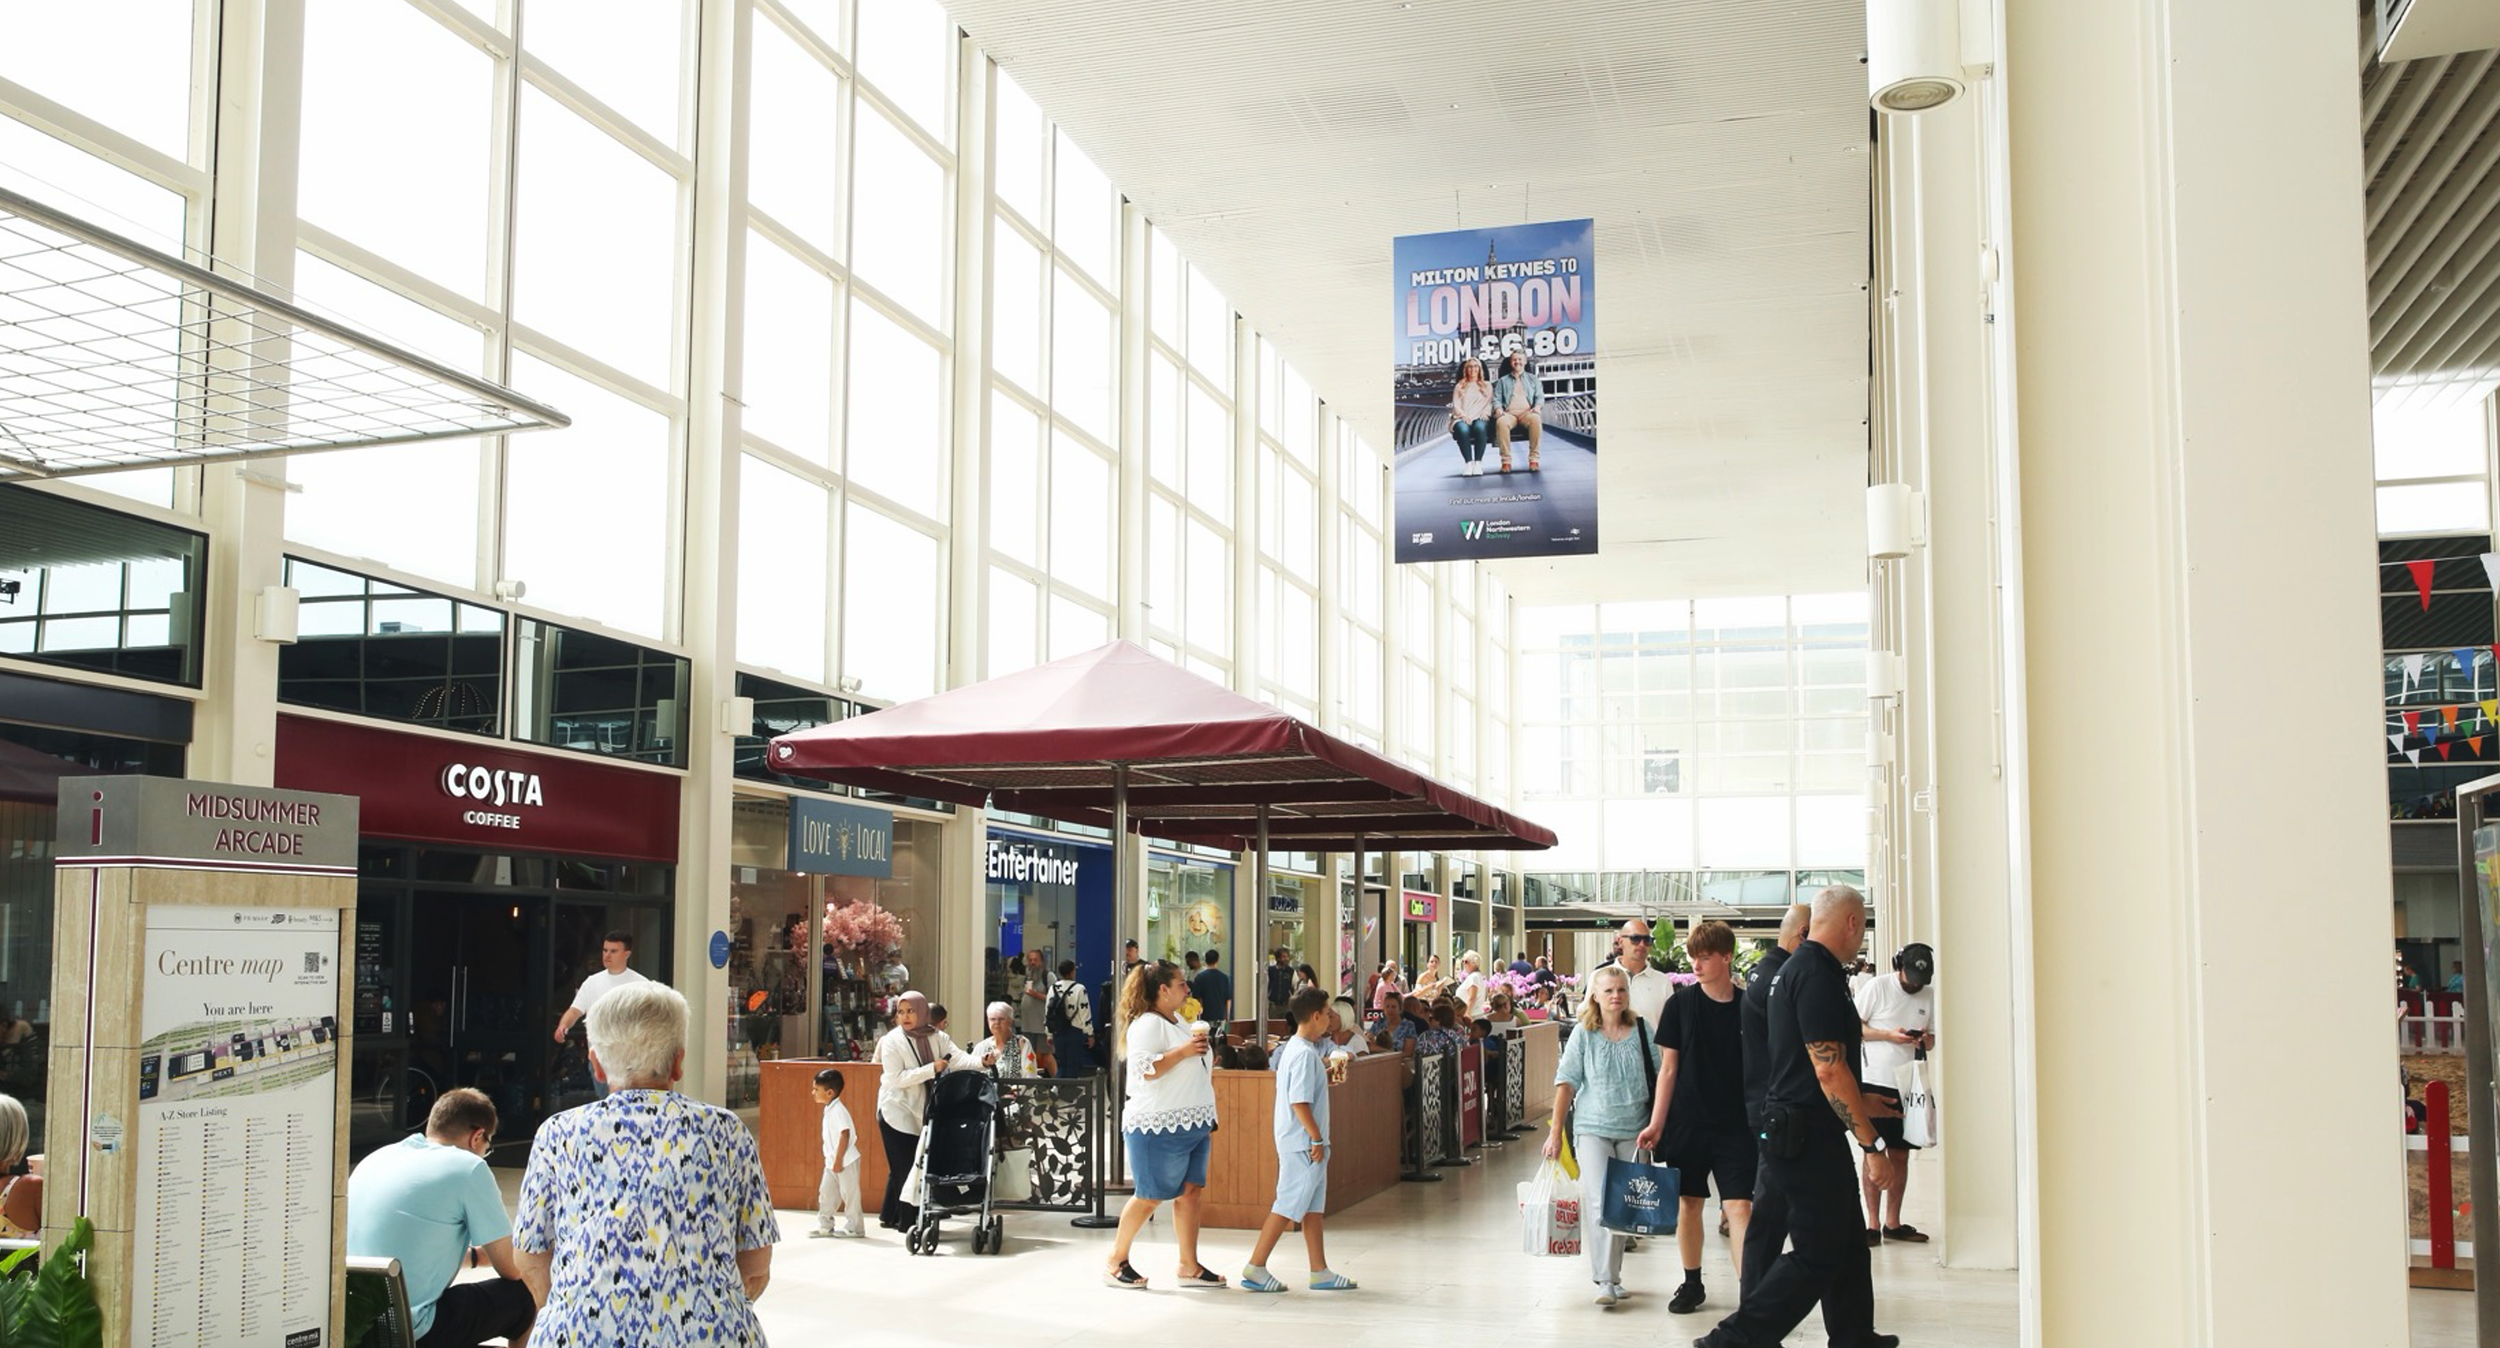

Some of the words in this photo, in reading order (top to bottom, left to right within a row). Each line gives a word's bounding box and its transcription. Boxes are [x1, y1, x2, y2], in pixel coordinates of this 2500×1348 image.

[1411, 266, 1479, 288] MILTON
[1484, 259, 1556, 280] KEYNES
[1560, 257, 1577, 274] TO
[1406, 274, 1582, 338] LONDON
[1411, 337, 1472, 366] FROM
[1478, 327, 1578, 361] £6.80
[1486, 519, 1511, 527] London
[1486, 525, 1531, 534] Northwestern
[1486, 532, 1511, 540] Railway
[445, 763, 543, 807] COSTA
[186, 793, 320, 827] MIDSUMMER
[465, 810, 521, 829] COFFEE
[212, 828, 304, 856] ARCADE
[803, 815, 832, 856] LOVE
[857, 823, 887, 862] LOCAL
[988, 842, 1079, 886] Entertainer
[158, 950, 234, 976] Centre
[240, 957, 283, 983] map
[203, 1002, 225, 1016] You
[227, 1006, 246, 1016] are
[249, 1001, 274, 1015] here
[214, 1068, 233, 1078] NEXT
[161, 1110, 175, 1121] A-Z
[177, 1109, 198, 1120] Store
[200, 1106, 228, 1118] Listing
[1624, 1194, 1660, 1207] Whittard
